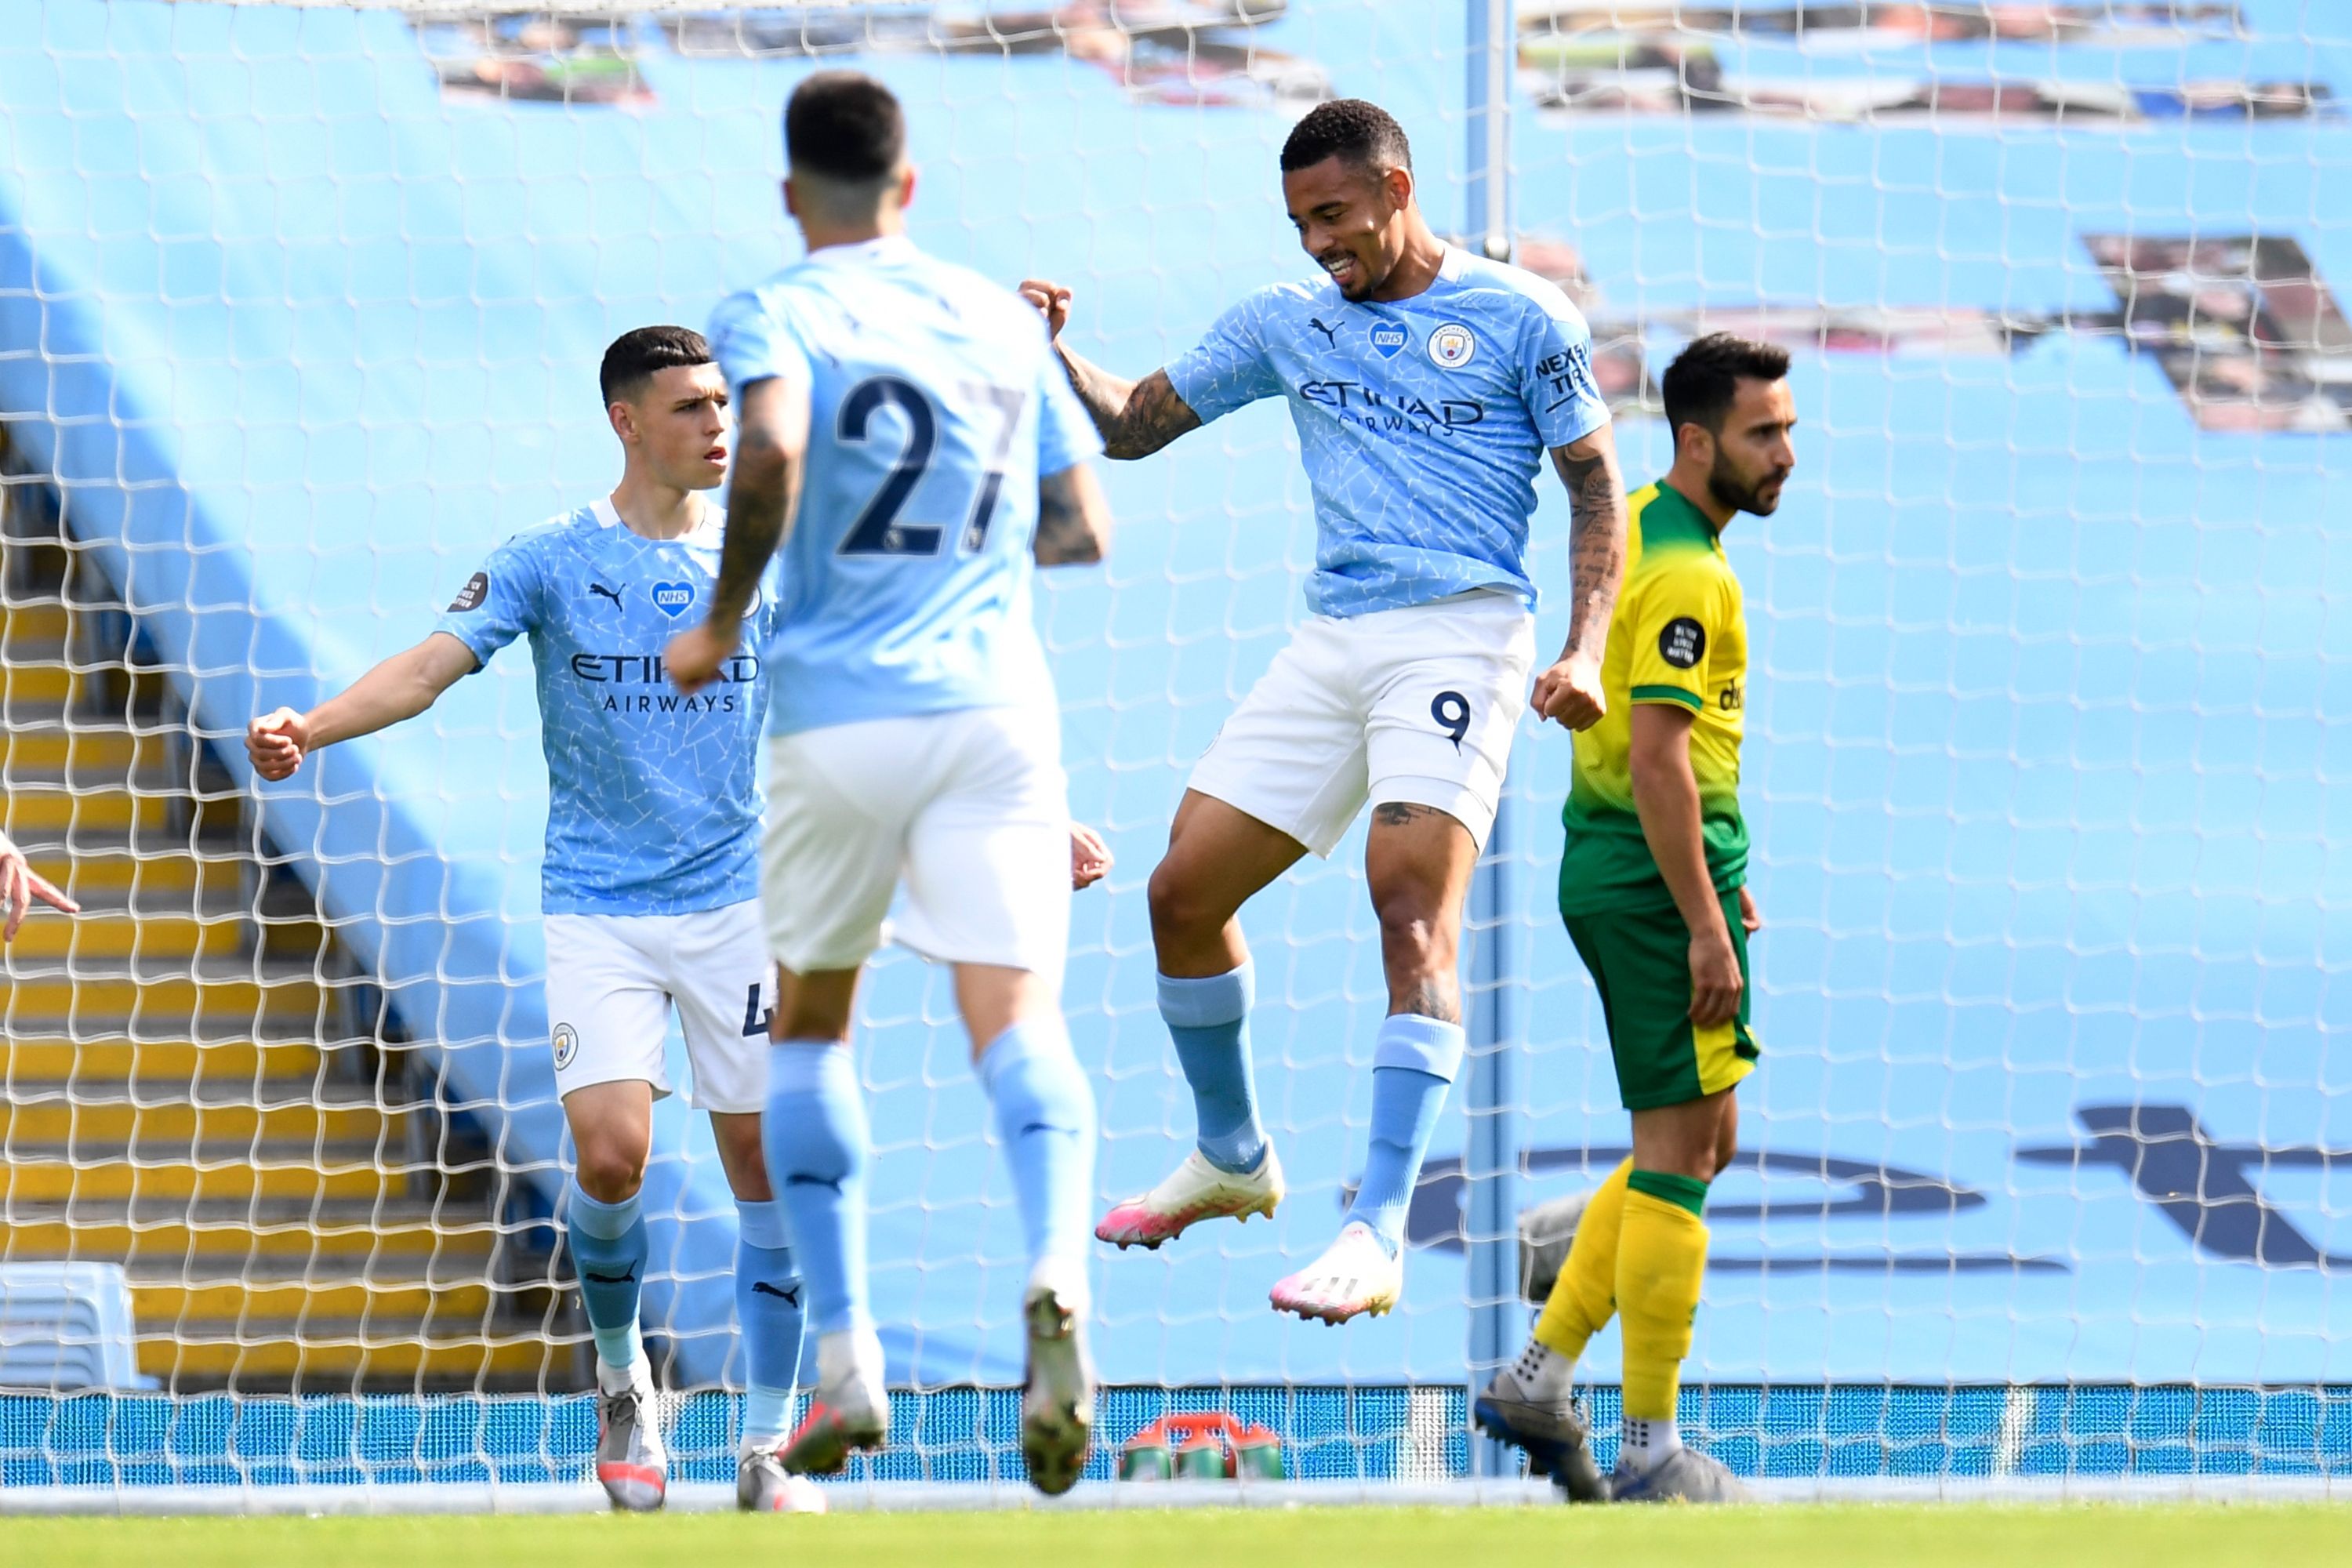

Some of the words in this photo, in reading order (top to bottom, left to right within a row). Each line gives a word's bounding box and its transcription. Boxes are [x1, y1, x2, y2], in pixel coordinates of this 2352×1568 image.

[1377, 333, 1402, 343] NHS
[1549, 367, 1588, 394] TIR
[836, 374, 1025, 556] 27
[660, 592, 686, 602] NHS
[571, 654, 759, 684] ETID
[604, 695, 734, 713] AIRWAYS
[1431, 691, 1470, 757] 9
